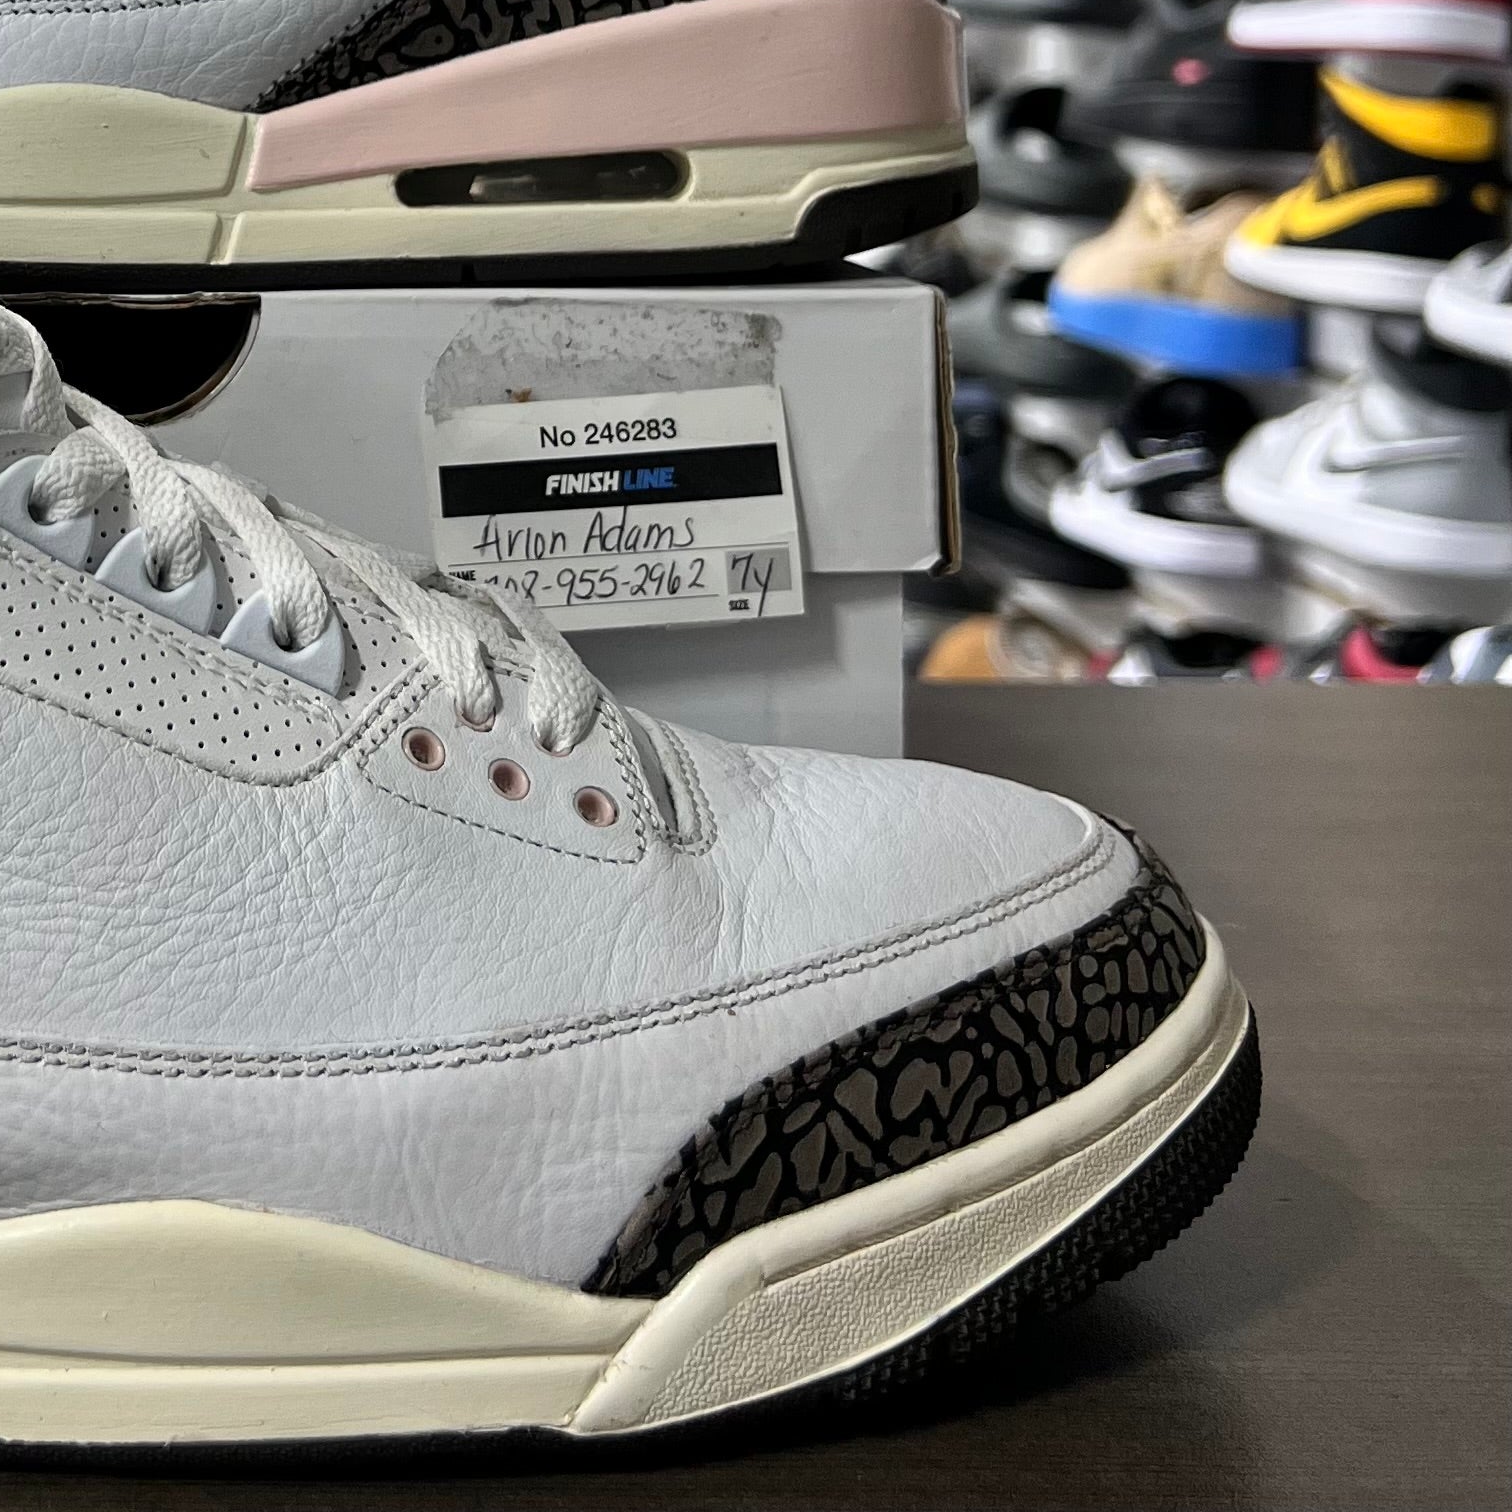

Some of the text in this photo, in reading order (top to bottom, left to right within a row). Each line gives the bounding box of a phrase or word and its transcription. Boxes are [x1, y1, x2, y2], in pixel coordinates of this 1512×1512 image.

[539, 417, 678, 448] No 246283
[545, 466, 676, 496] FINISH LINE
[583, 505, 694, 554] Adams
[484, 557, 705, 606] 8-955-2962
